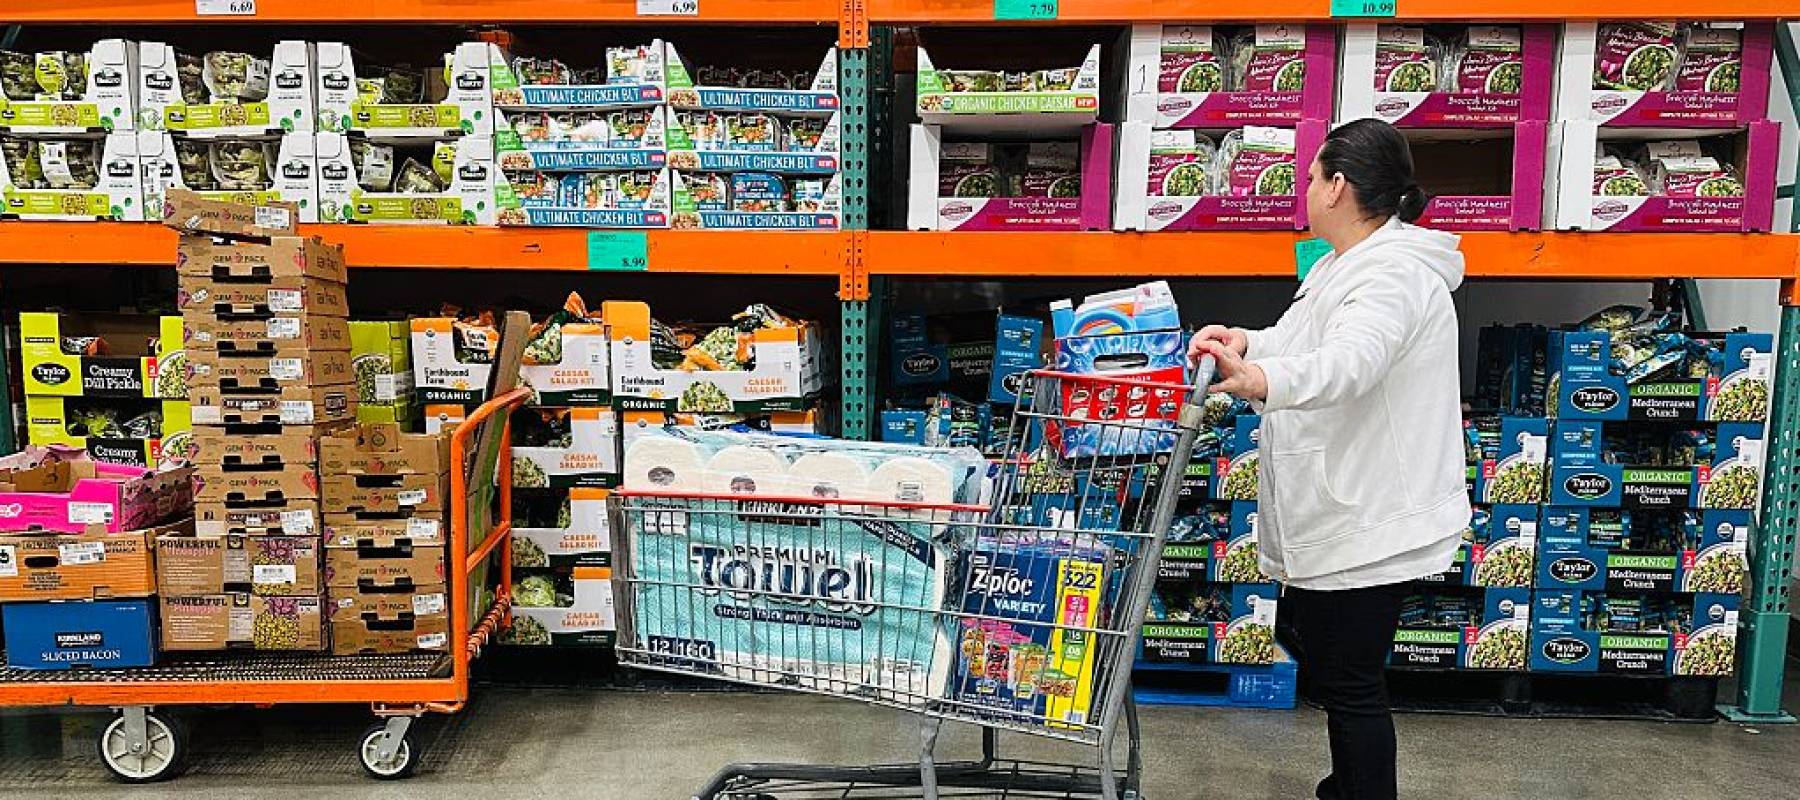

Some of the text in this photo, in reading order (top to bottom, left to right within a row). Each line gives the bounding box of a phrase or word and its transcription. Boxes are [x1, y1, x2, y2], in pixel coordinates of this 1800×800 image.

[228, 1, 252, 12] 6.69
[672, 1, 696, 13] 6.99
[1030, 4, 1054, 15] 7.79
[1362, 3, 1393, 13] 10.99
[529, 88, 639, 103] ULTIMATE CHICKEN BLT
[704, 92, 816, 107] ULTIMATE CHICKEN BLT
[954, 97, 1074, 110] ORGANIC CHICKEN CAESAR
[537, 152, 647, 167] ULTIMATE CHICKEN BLT
[704, 155, 814, 168] ULTIMATE CHICKEN BLT
[200, 210, 219, 218] GEM
[533, 211, 643, 223] ULTIMATE CHICKEN BLT
[706, 214, 816, 227] ULTIMATE CHICKEN BLT
[213, 255, 265, 263] GEM PACK
[621, 257, 646, 268] 8.99
[213, 294, 265, 302] GEM PACK
[216, 331, 267, 339] GEM PACK
[36, 366, 66, 377] Taylor
[89, 364, 134, 378] Creamy
[218, 368, 270, 376] GEM PACK
[424, 368, 469, 377] Earthbound
[84, 377, 141, 390] Dill Pickle
[425, 376, 444, 384] Farm
[621, 375, 665, 386] Earthbound
[621, 385, 642, 393] Farm
[1637, 385, 1694, 394] ORGANIC
[426, 392, 471, 400] ORGANIC
[1579, 391, 1614, 403] Taylor
[623, 401, 666, 409] ORGANIC
[1632, 399, 1695, 408] Mediterranean
[1646, 408, 1679, 418] Crunch
[94, 445, 138, 458] Creamy
[225, 444, 276, 452] GEM PACK
[563, 453, 598, 461] CAESAR
[559, 461, 586, 469] SALAD
[1630, 472, 1685, 481] ORGANIC
[229, 479, 280, 487] GEM PACK
[1572, 478, 1606, 490] Taylor
[1625, 486, 1688, 495] Mediterranean
[1639, 495, 1671, 504] Crunch
[357, 529, 407, 537] GEM PACK
[159, 540, 221, 549] POWERFUL
[735, 544, 836, 567] PREMIUM
[1614, 557, 1669, 567] ORGANIC
[1556, 562, 1591, 573] Taylor
[1158, 569, 1190, 577] Crunch
[1609, 570, 1672, 580] Mediterranean
[690, 543, 877, 617] Towel
[971, 566, 1033, 599] Ziploc
[1623, 579, 1655, 588] Crunch
[166, 597, 228, 606] POWERFUL
[994, 598, 1047, 615] VARIETY
[360, 603, 409, 611] GEM PACK
[562, 619, 587, 627] SALAD
[1149, 626, 1202, 636] ORGANIC
[1400, 631, 1452, 641] ORGANIC
[57, 634, 101, 643] KIRKLAND
[1608, 637, 1662, 647] ORGANIC
[651, 639, 672, 655] 12
[1145, 639, 1206, 650] Mediterranean
[1394, 644, 1456, 655] Mediterranean
[1549, 643, 1585, 654] Taylor
[41, 649, 121, 662] SLICED BACON
[1159, 647, 1190, 658] Crunch
[1602, 651, 1664, 661] Mediterranean
[1408, 653, 1440, 663] Crunch
[1616, 660, 1648, 669] Crunch
